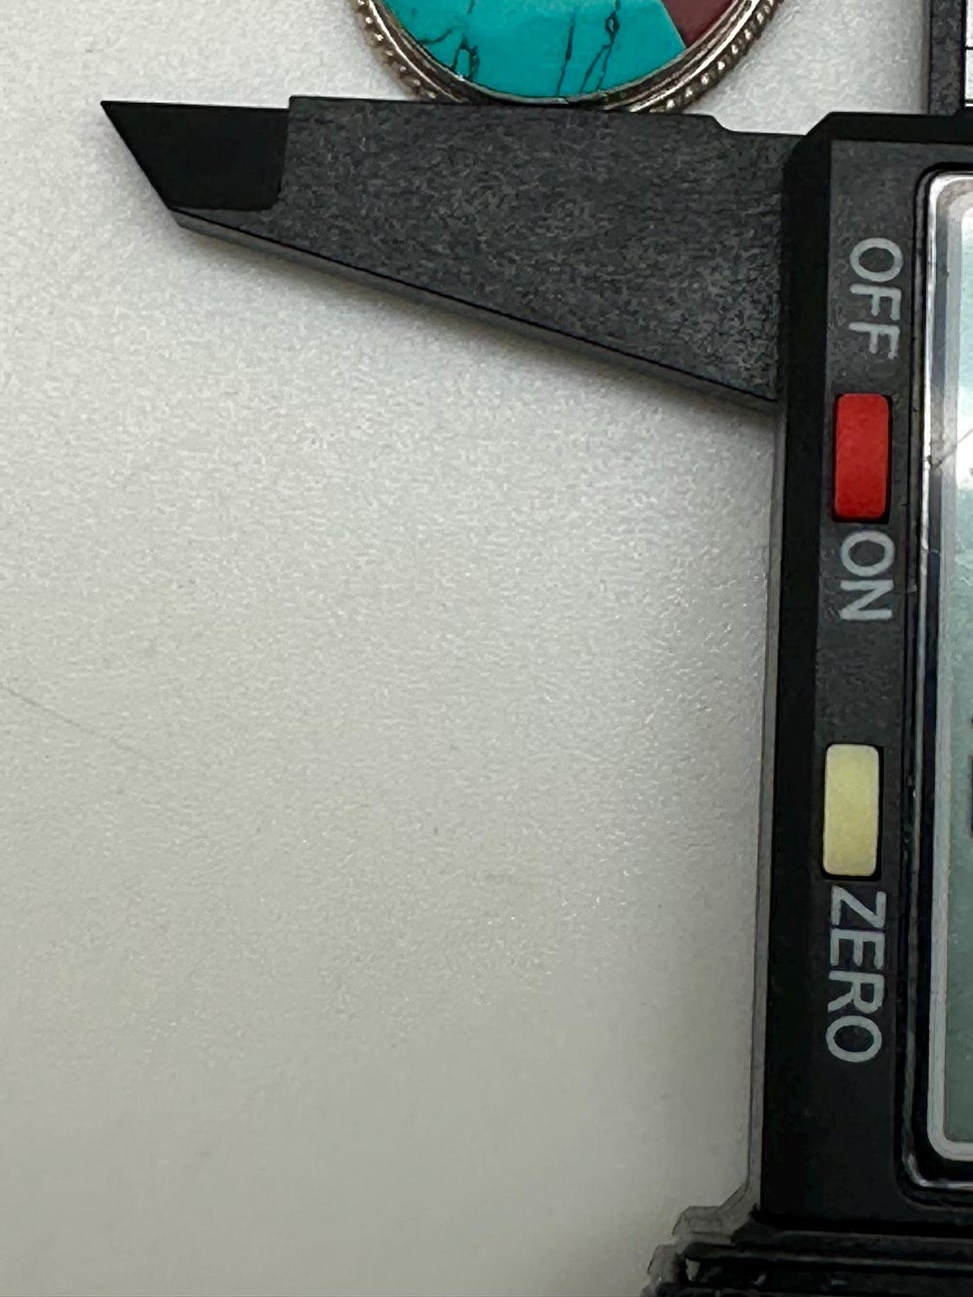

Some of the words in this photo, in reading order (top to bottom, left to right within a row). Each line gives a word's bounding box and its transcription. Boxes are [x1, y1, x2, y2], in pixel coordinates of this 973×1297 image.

[848, 237, 902, 360] OFF
[839, 531, 896, 621] ON
[825, 884, 887, 1063] ZERO
